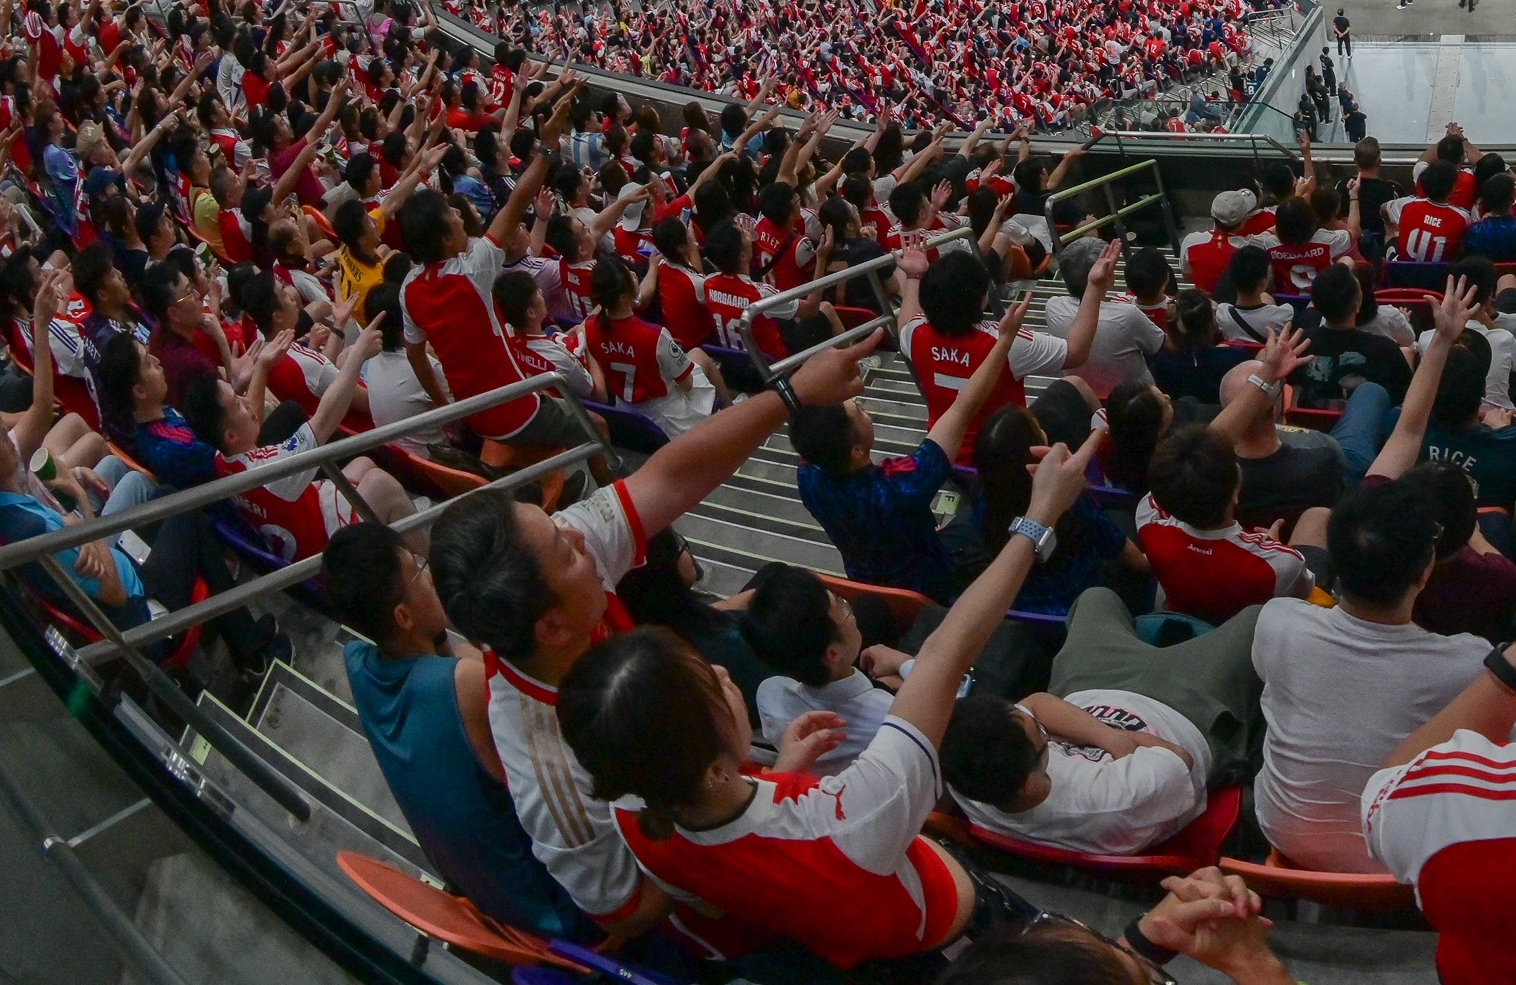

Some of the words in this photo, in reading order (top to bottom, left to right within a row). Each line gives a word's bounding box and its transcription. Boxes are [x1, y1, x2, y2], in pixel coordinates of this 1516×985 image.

[1423, 214, 1443, 229] RICE
[1406, 227, 1447, 263] 41
[709, 288, 750, 309] NØRGAARD
[601, 341, 635, 359] SAKA
[931, 346, 970, 367] SAKA
[610, 362, 637, 403] 7
[1429, 445, 1477, 472] RICE
[1187, 543, 1213, 555] Arsenal
